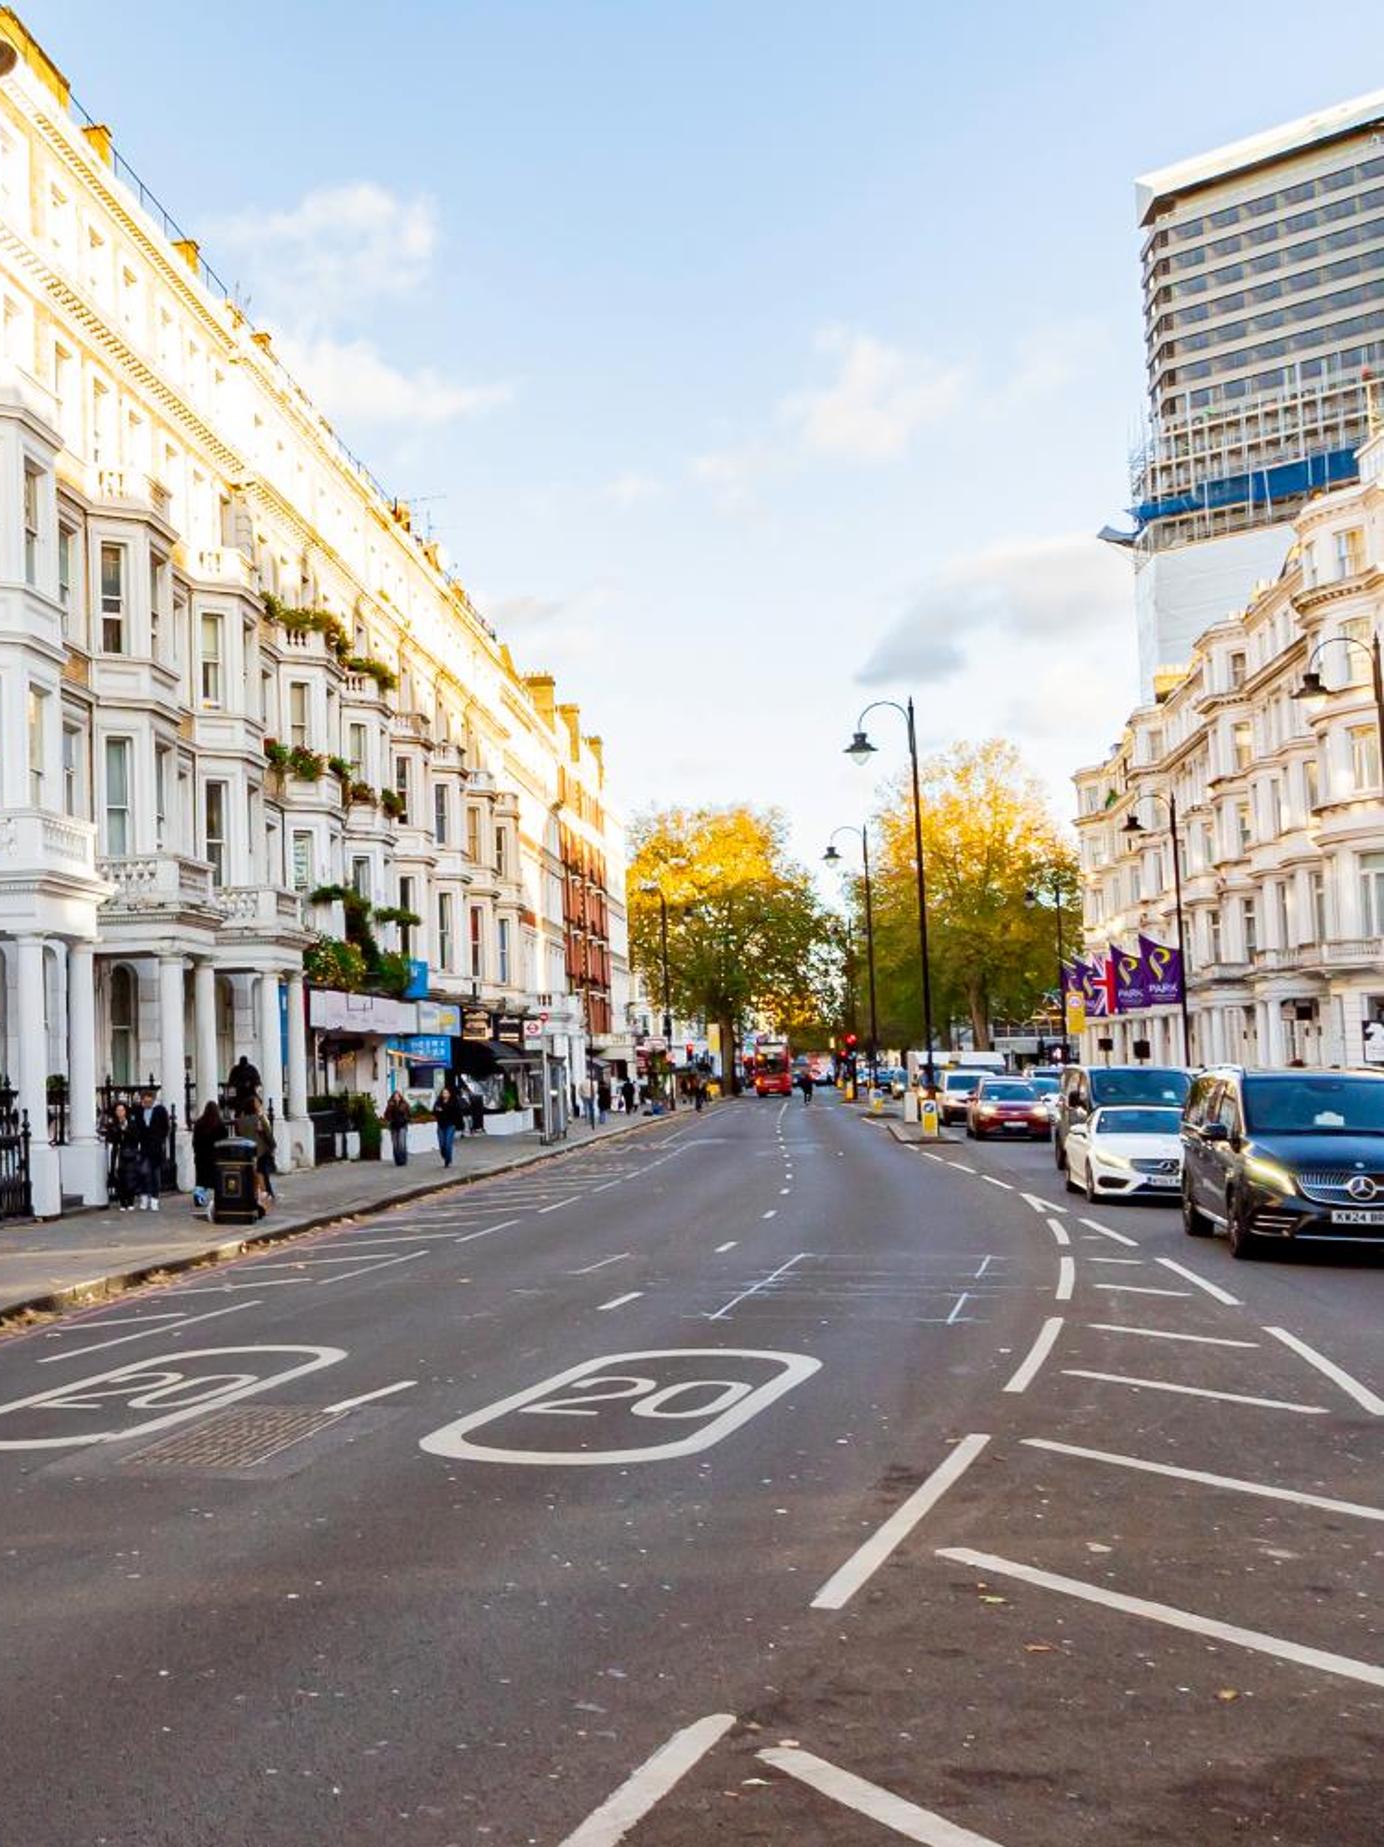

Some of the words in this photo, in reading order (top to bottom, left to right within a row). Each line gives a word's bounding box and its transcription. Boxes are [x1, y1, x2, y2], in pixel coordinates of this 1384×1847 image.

[1118, 989, 1144, 998] PARK
[1149, 983, 1178, 993] PARK
[30, 1372, 259, 1408] 20
[517, 1376, 753, 1418] 20
